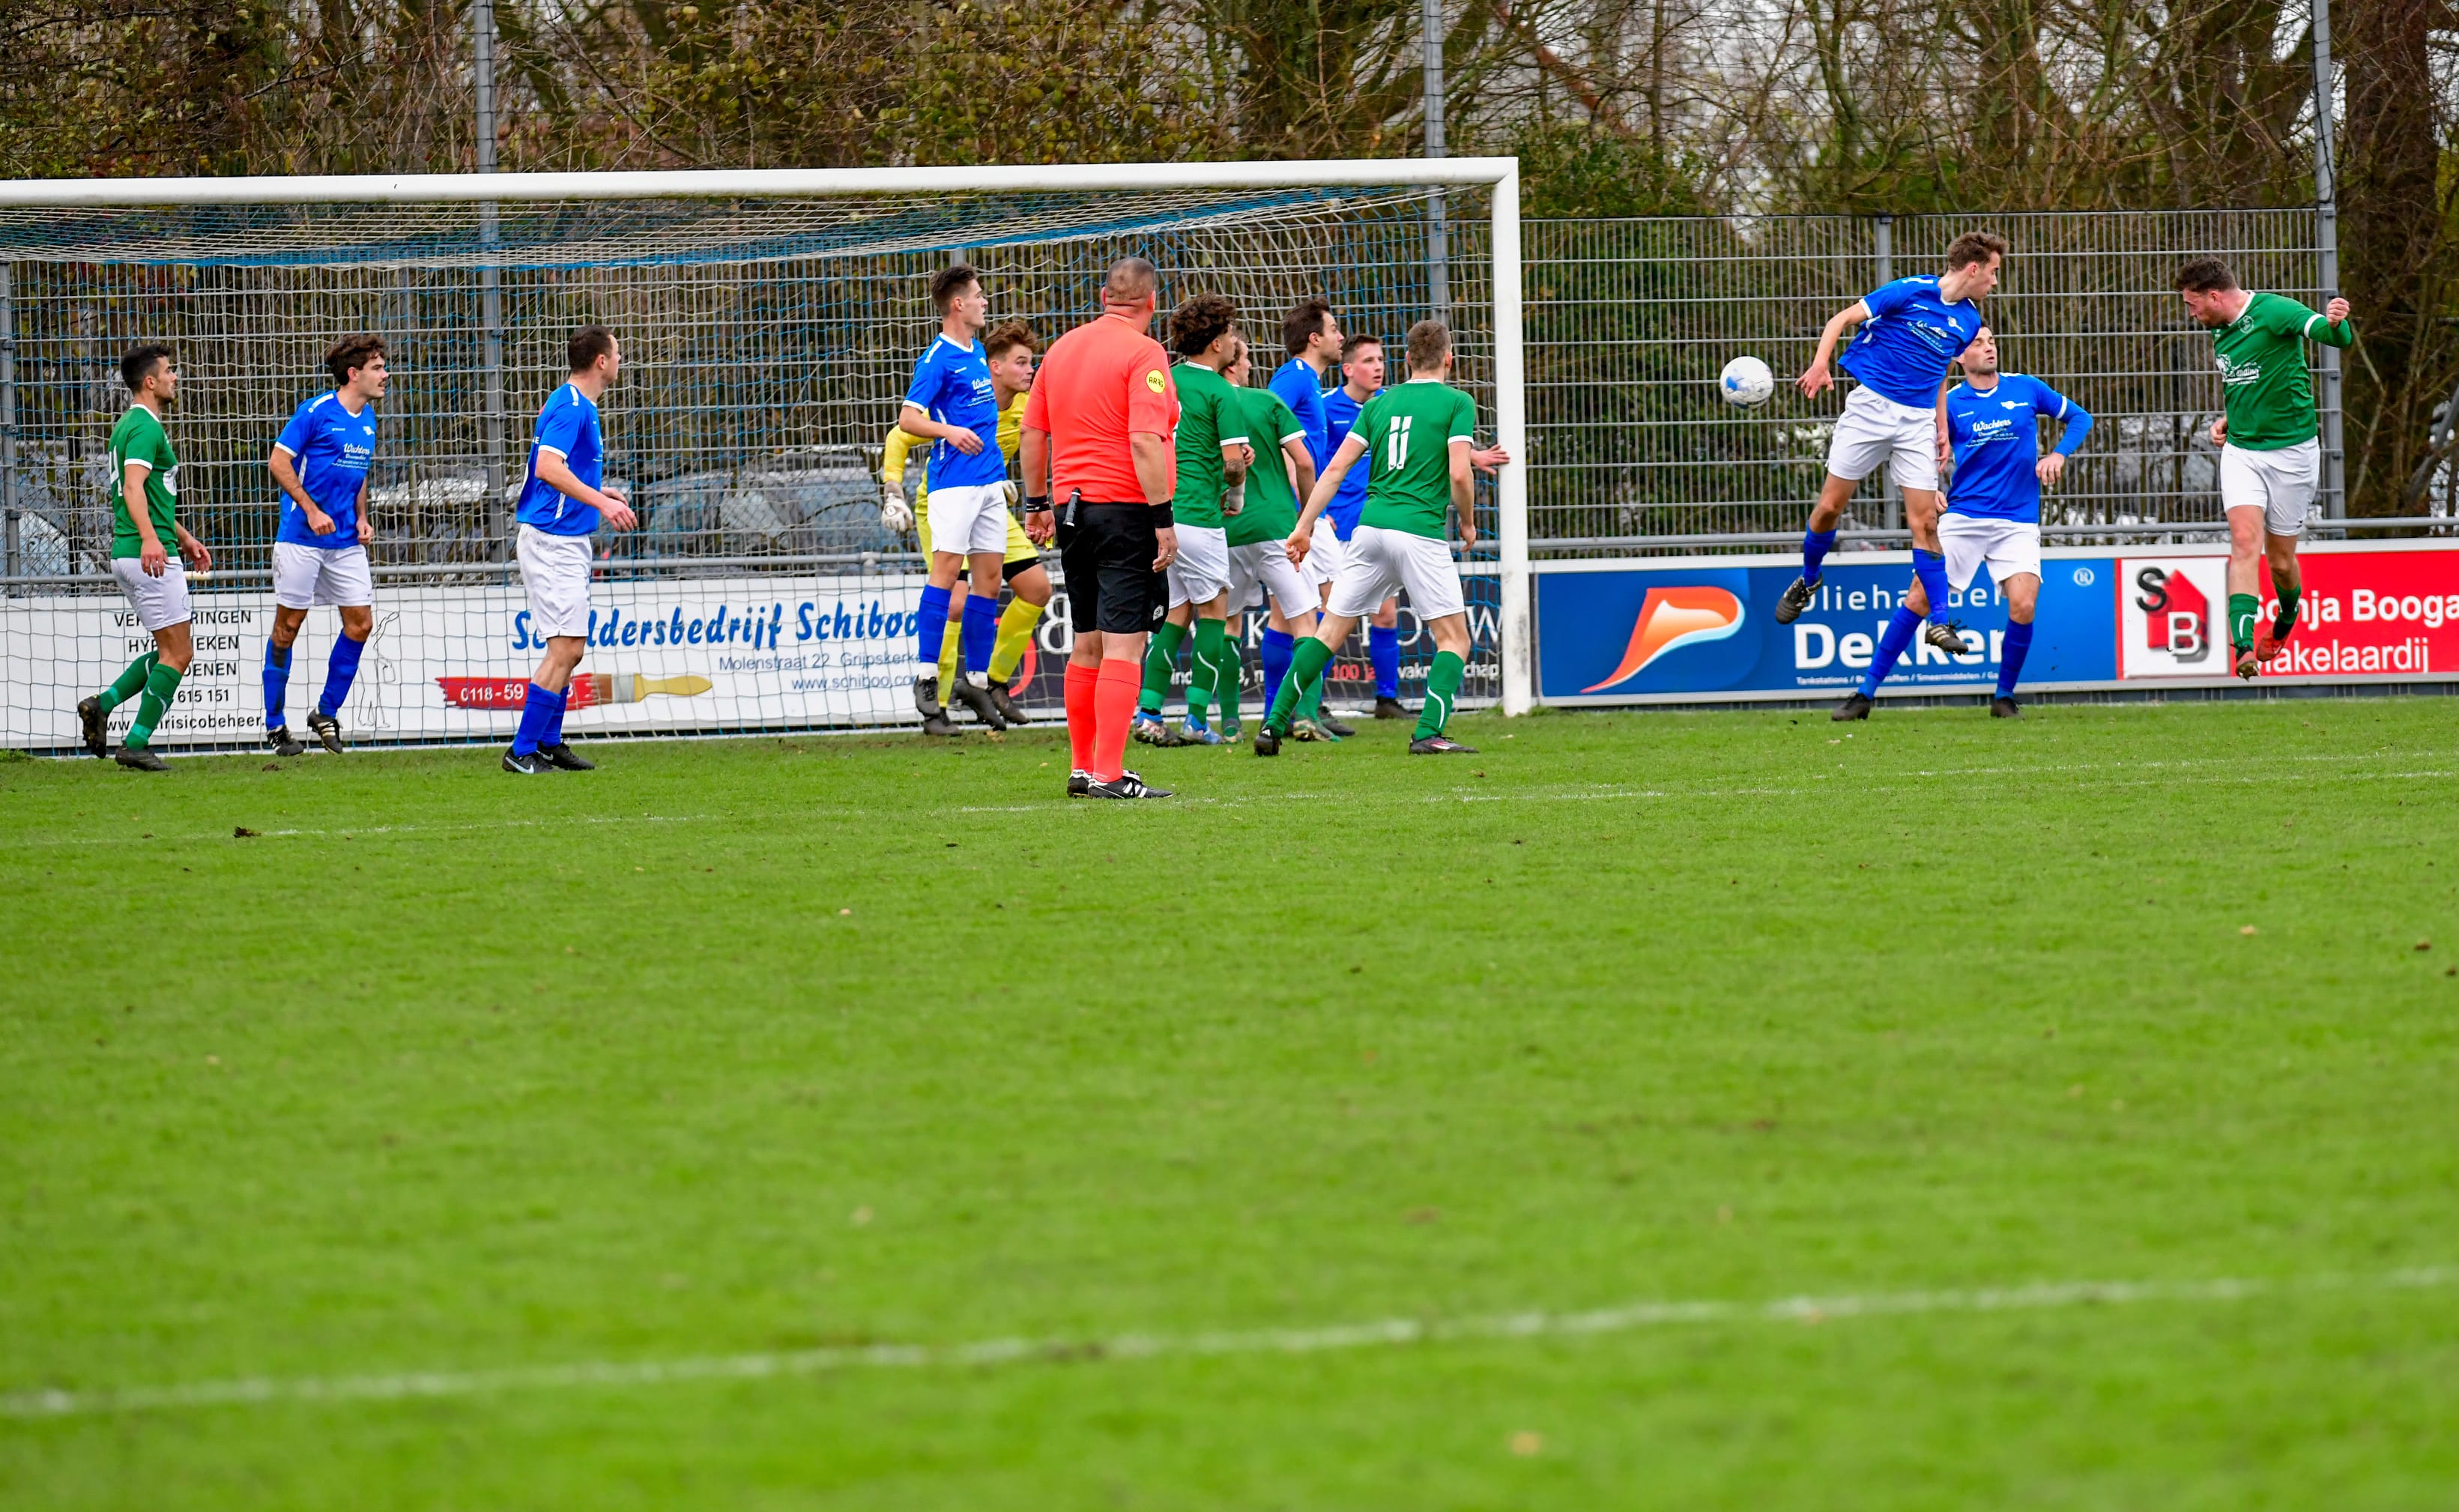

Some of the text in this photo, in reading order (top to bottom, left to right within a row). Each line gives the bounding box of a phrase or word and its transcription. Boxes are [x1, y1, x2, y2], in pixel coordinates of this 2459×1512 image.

[1149, 376, 1164, 387] ARAG
[1388, 416, 1412, 471] 11
[512, 602, 781, 650] Scldersbedrijf
[2167, 611, 2201, 656] B
[719, 654, 807, 671] Molenstraat
[812, 654, 829, 668] 22
[1332, 664, 1359, 680] 100
[1397, 661, 1499, 681] vakmchap
[178, 689, 229, 703] 615 151
